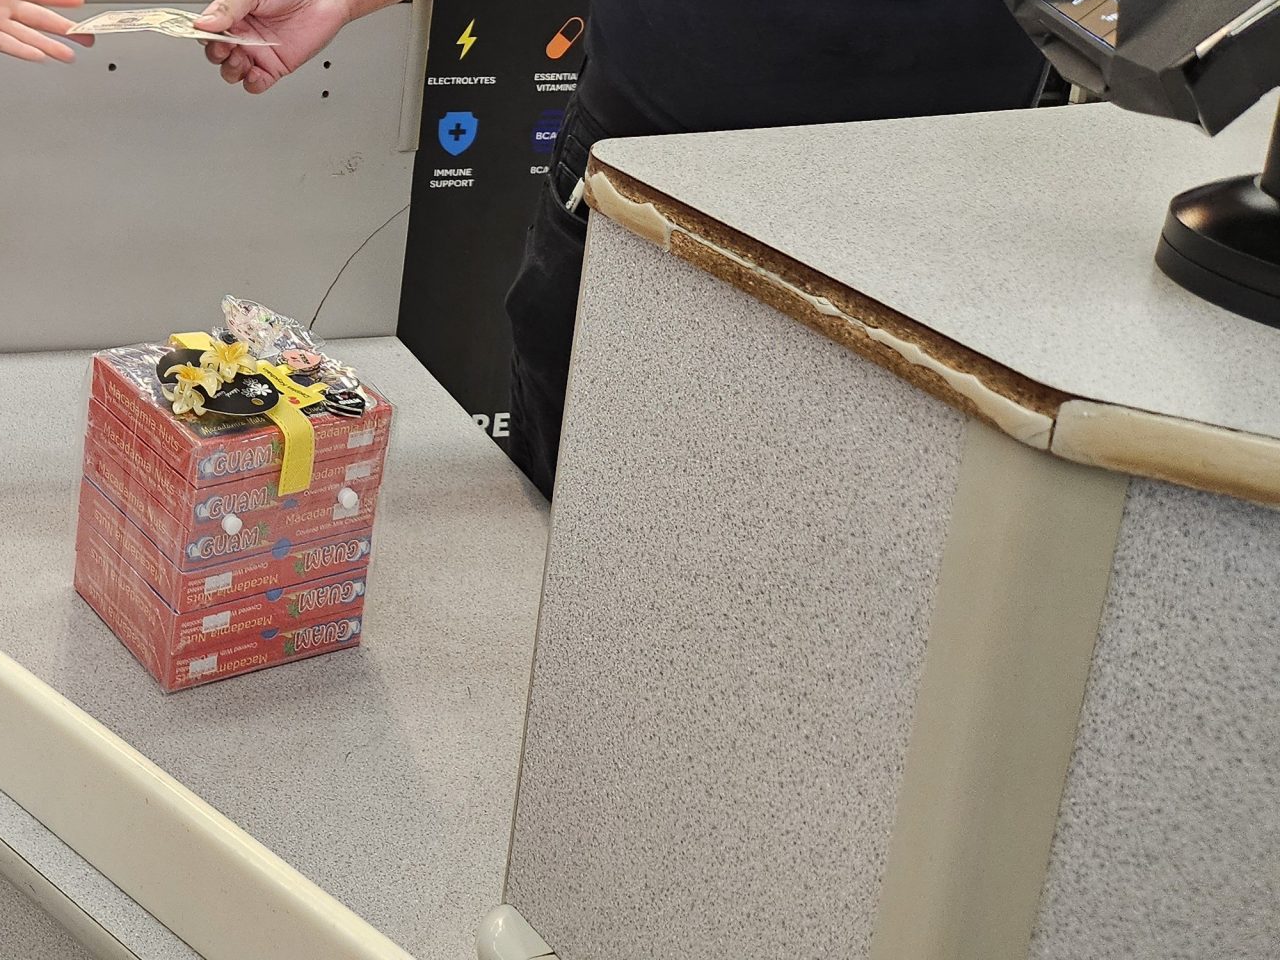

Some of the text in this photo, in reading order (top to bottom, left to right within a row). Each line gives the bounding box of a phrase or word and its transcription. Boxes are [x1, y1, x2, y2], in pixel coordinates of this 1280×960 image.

[427, 76, 496, 86] ELECTROLYTES
[429, 179, 475, 188] SUPPORT
[433, 168, 472, 177] IMMUNE
[108, 381, 181, 451] Macadamia Nuts
[200, 422, 246, 435] Macadamia
[103, 422, 152, 472] Macadamia
[213, 444, 272, 476] GUAM
[98, 461, 145, 513] Macadamia
[209, 487, 268, 520] GUAM
[200, 527, 259, 559] GUAM
[303, 539, 361, 571] GUAM
[217, 574, 278, 597] Macadamia
[298, 581, 355, 613] GUAM
[210, 615, 273, 638] Macadamia
[293, 619, 350, 651] GUAM
